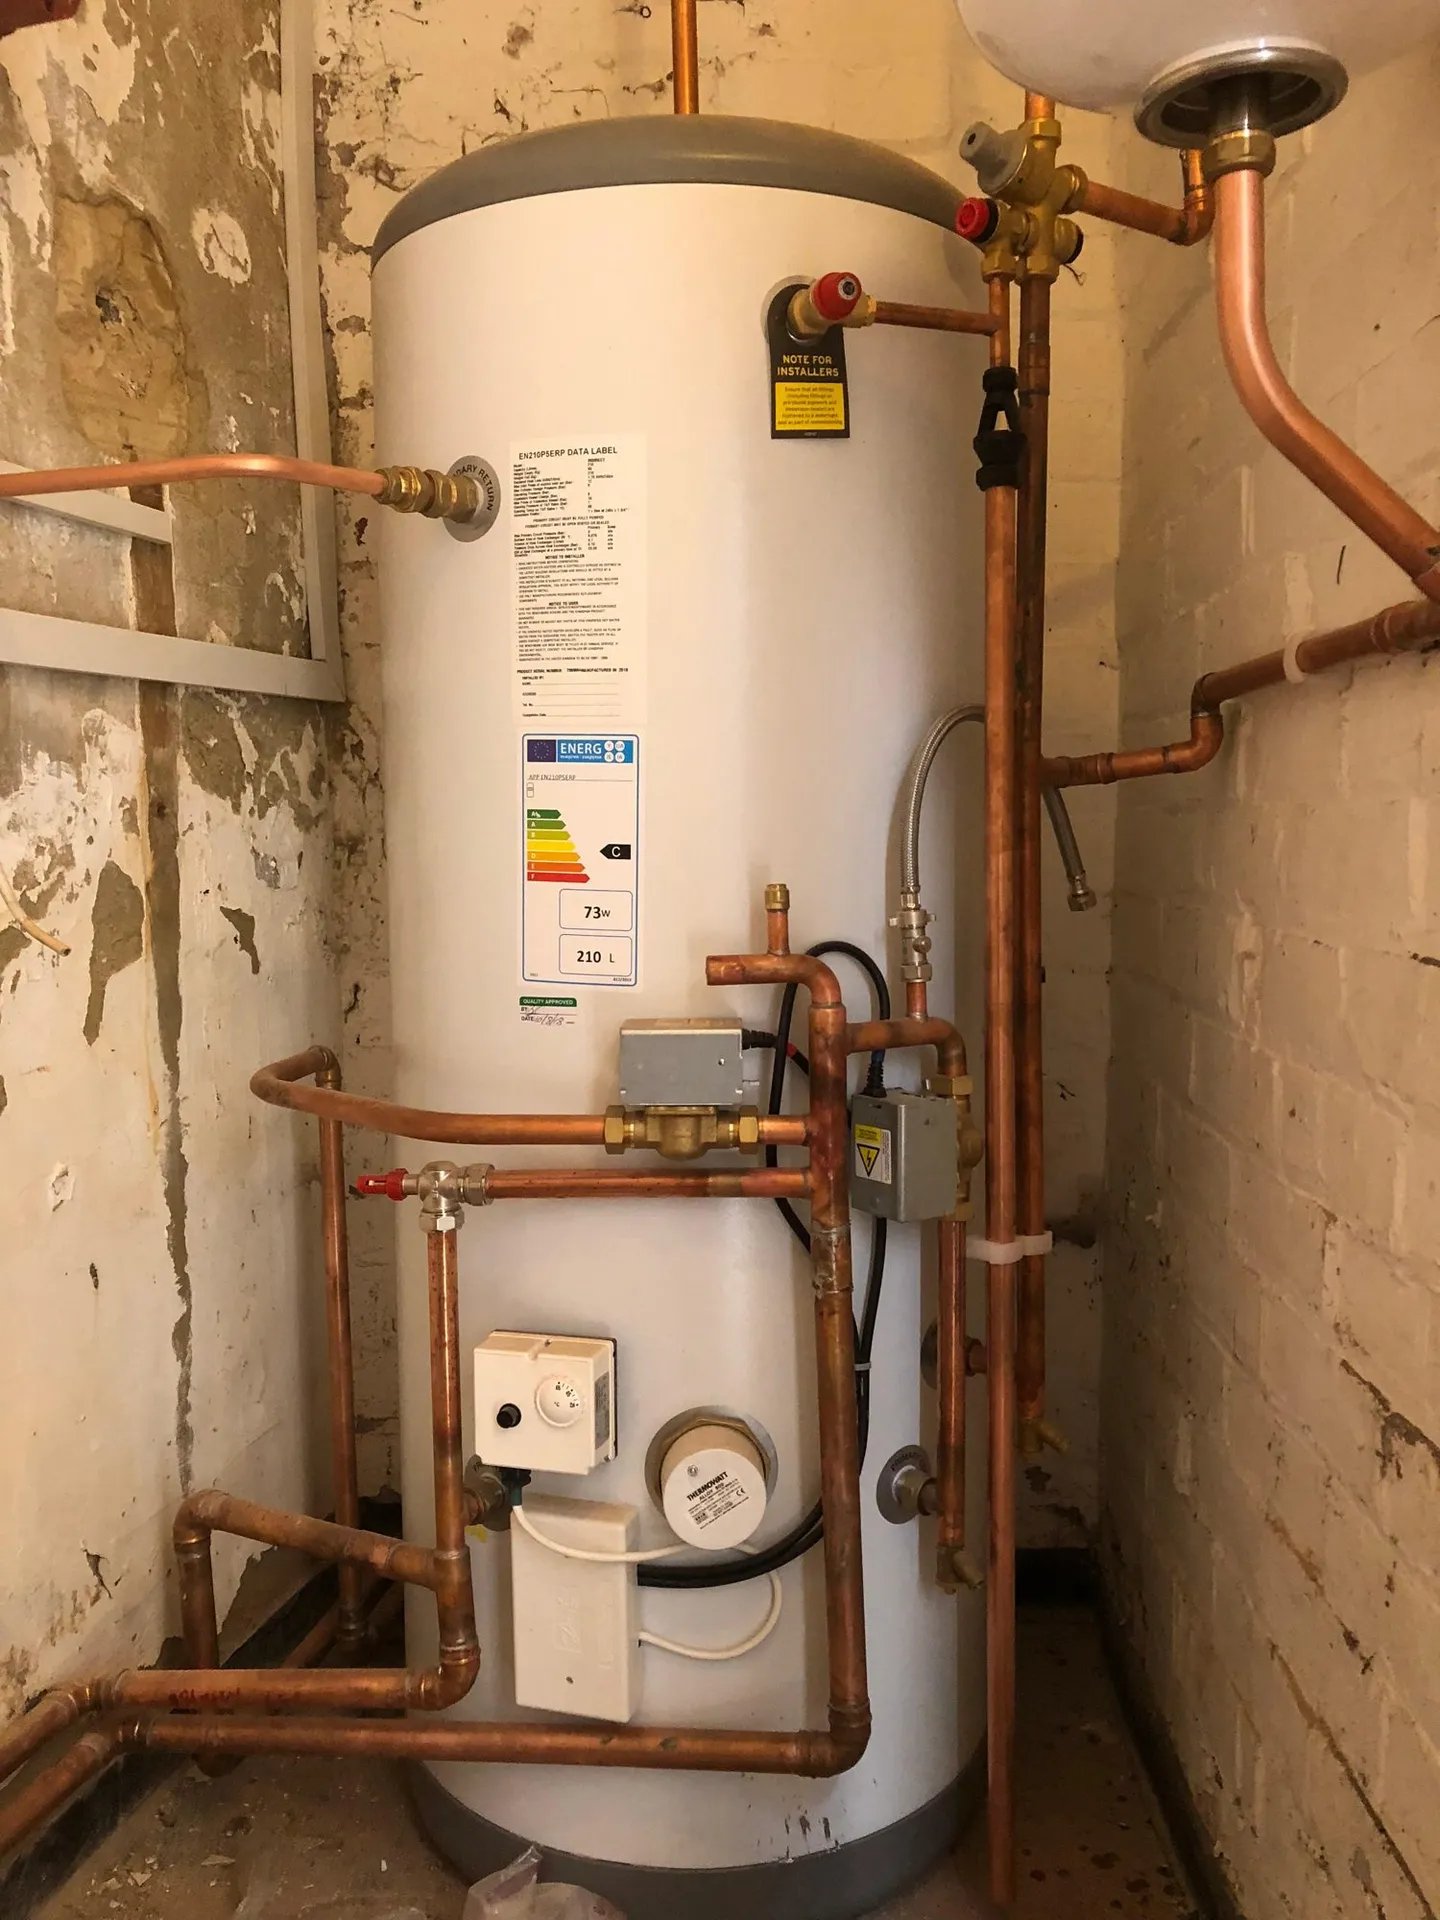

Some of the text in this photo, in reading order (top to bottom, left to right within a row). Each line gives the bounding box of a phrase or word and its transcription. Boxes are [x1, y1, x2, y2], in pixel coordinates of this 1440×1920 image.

[782, 354, 832, 365] NOTE FOR
[776, 366, 839, 377] INSTALLERS
[518, 446, 618, 460] EN210P5ERP DATA LABEL
[452, 464, 478, 476] DARY
[478, 468, 495, 511] RETURN
[560, 743, 602, 754] ENERG
[611, 846, 621, 857] C
[576, 950, 615, 963] 210 L
[686, 1471, 728, 1501] THERMOWATT
